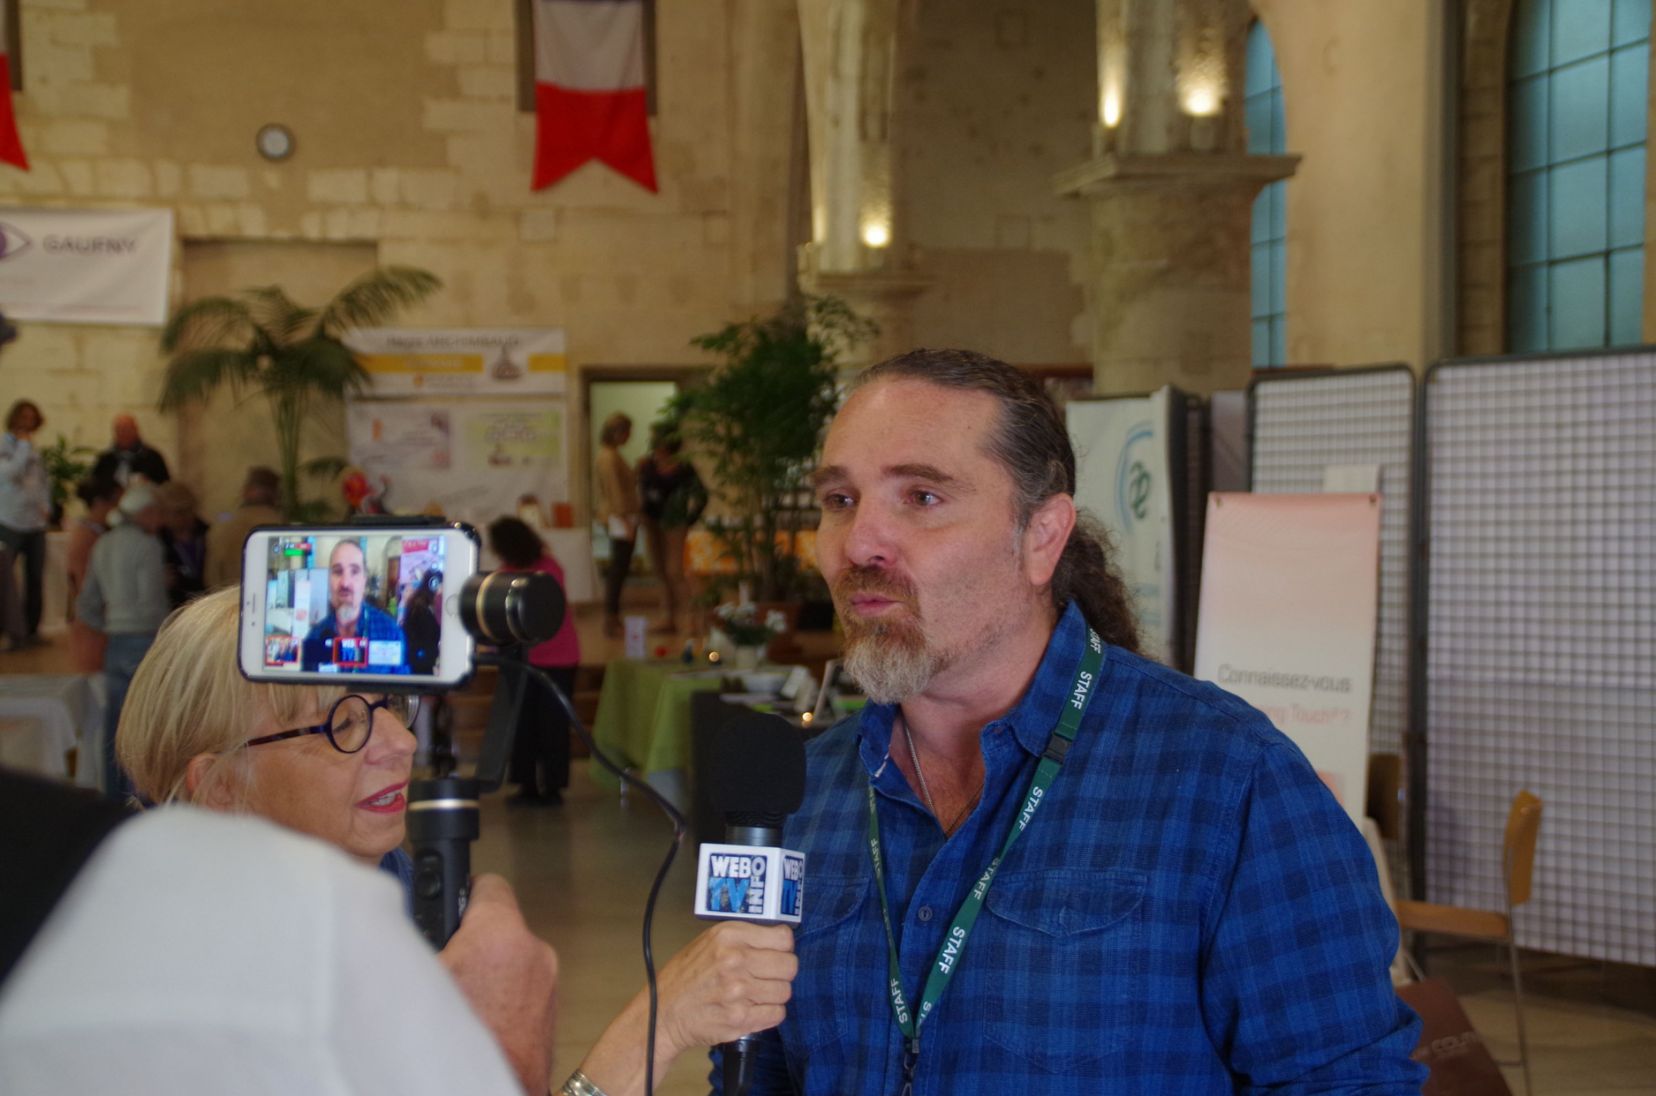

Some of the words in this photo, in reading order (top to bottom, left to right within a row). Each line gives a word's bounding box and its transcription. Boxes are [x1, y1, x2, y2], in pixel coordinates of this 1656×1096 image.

[1070, 670, 1093, 710] STAFF
[1018, 786, 1043, 832] STAFF
[973, 857, 1001, 900] STAFF
[938, 926, 966, 975] STAFF
[890, 977, 908, 1024] STAFF
